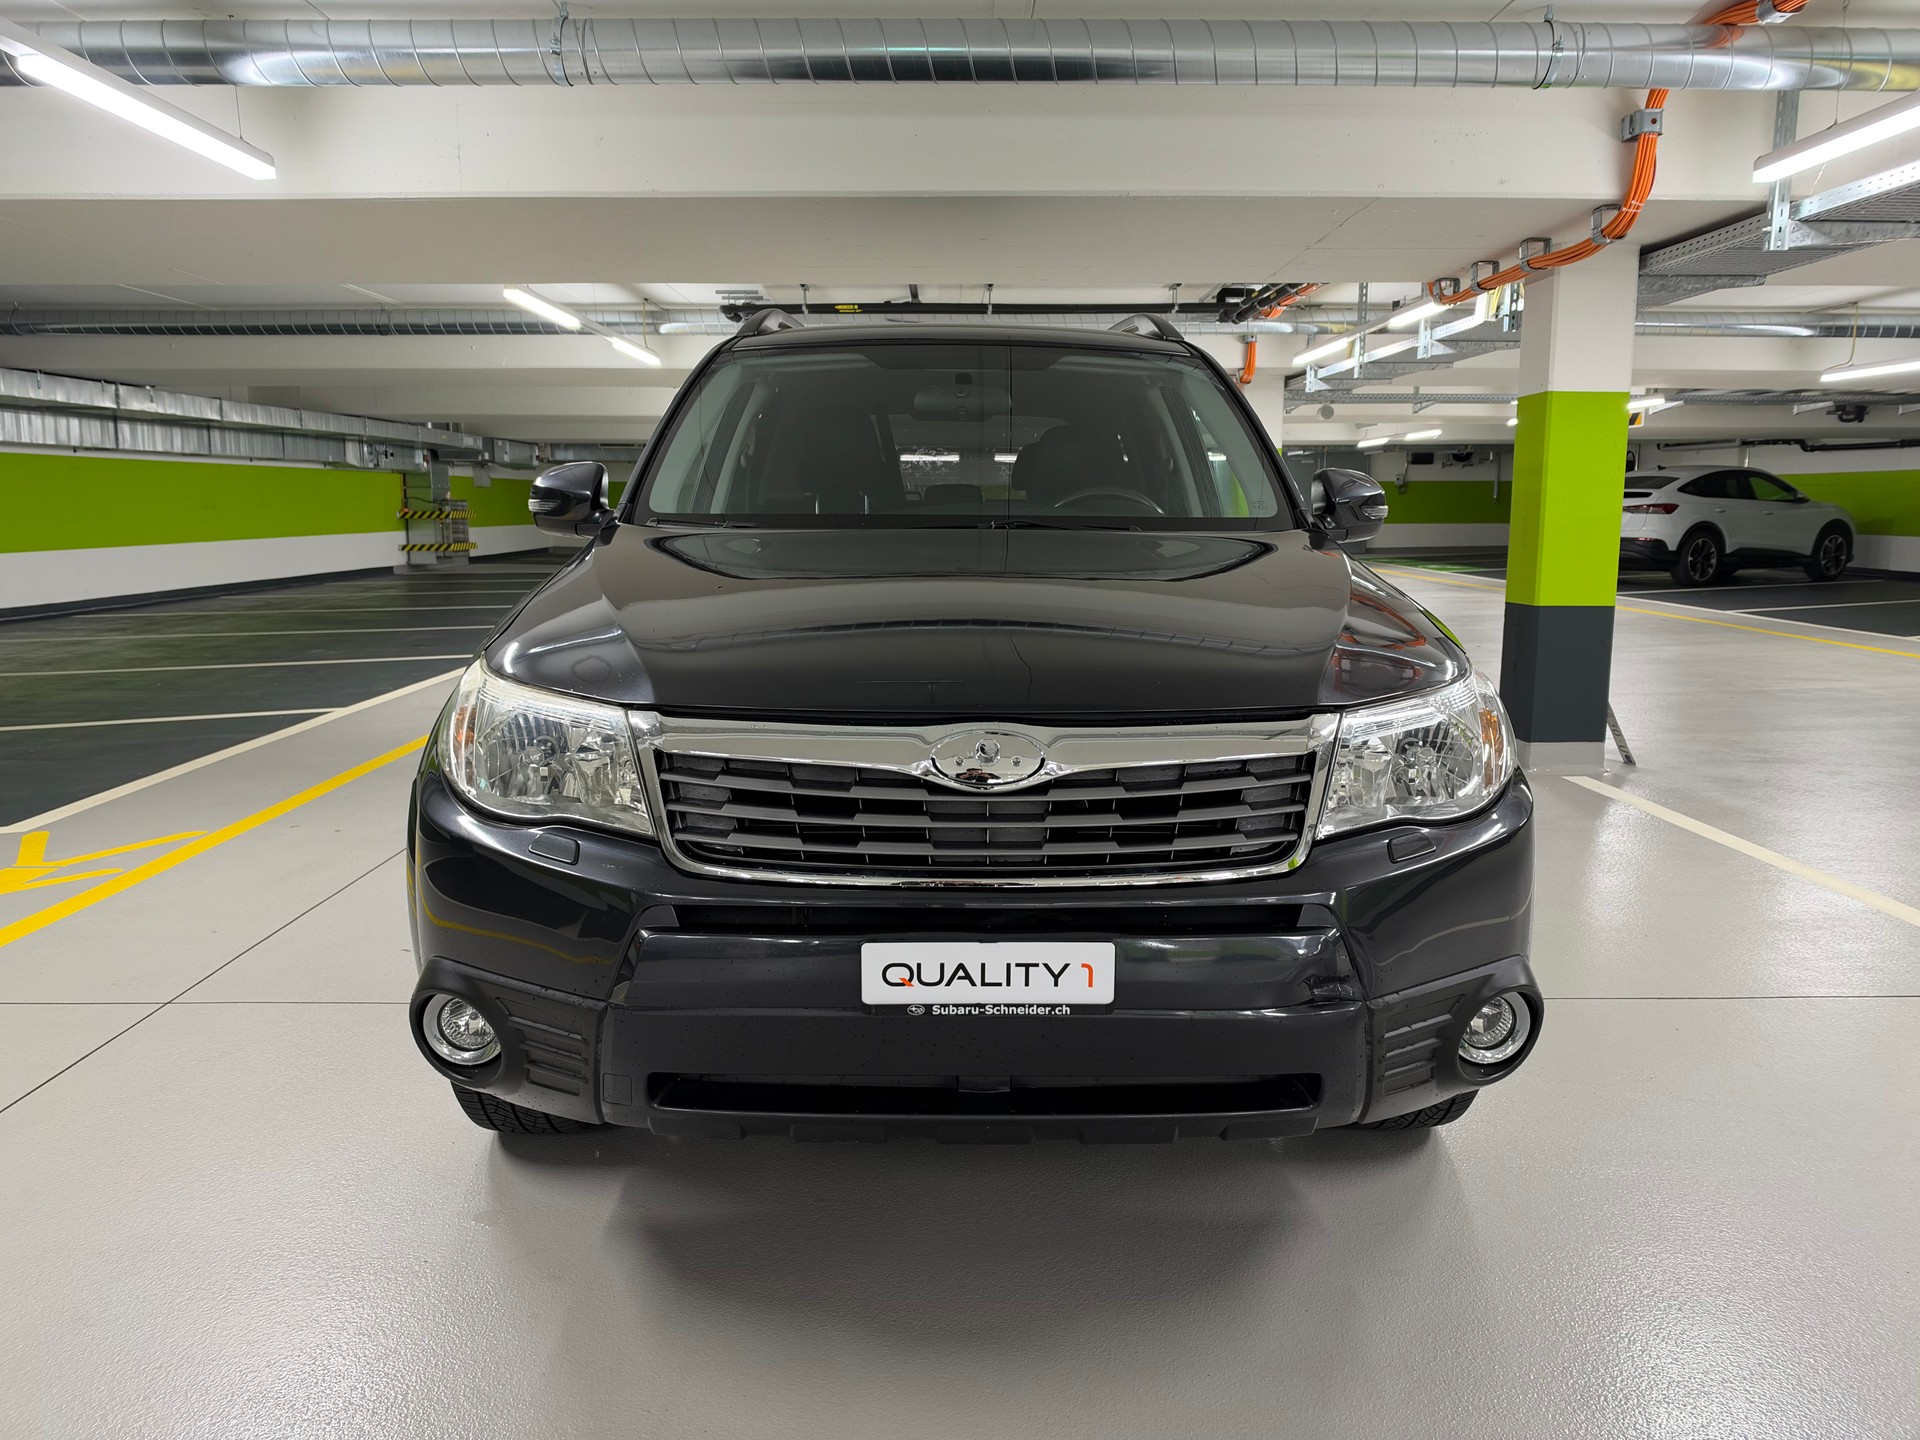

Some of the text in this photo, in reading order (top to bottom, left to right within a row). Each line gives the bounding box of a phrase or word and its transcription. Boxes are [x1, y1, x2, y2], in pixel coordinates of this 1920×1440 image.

[882, 962, 1094, 988] QUALITY 1
[931, 1004, 1071, 1015] Subaru-Schneider.ch
